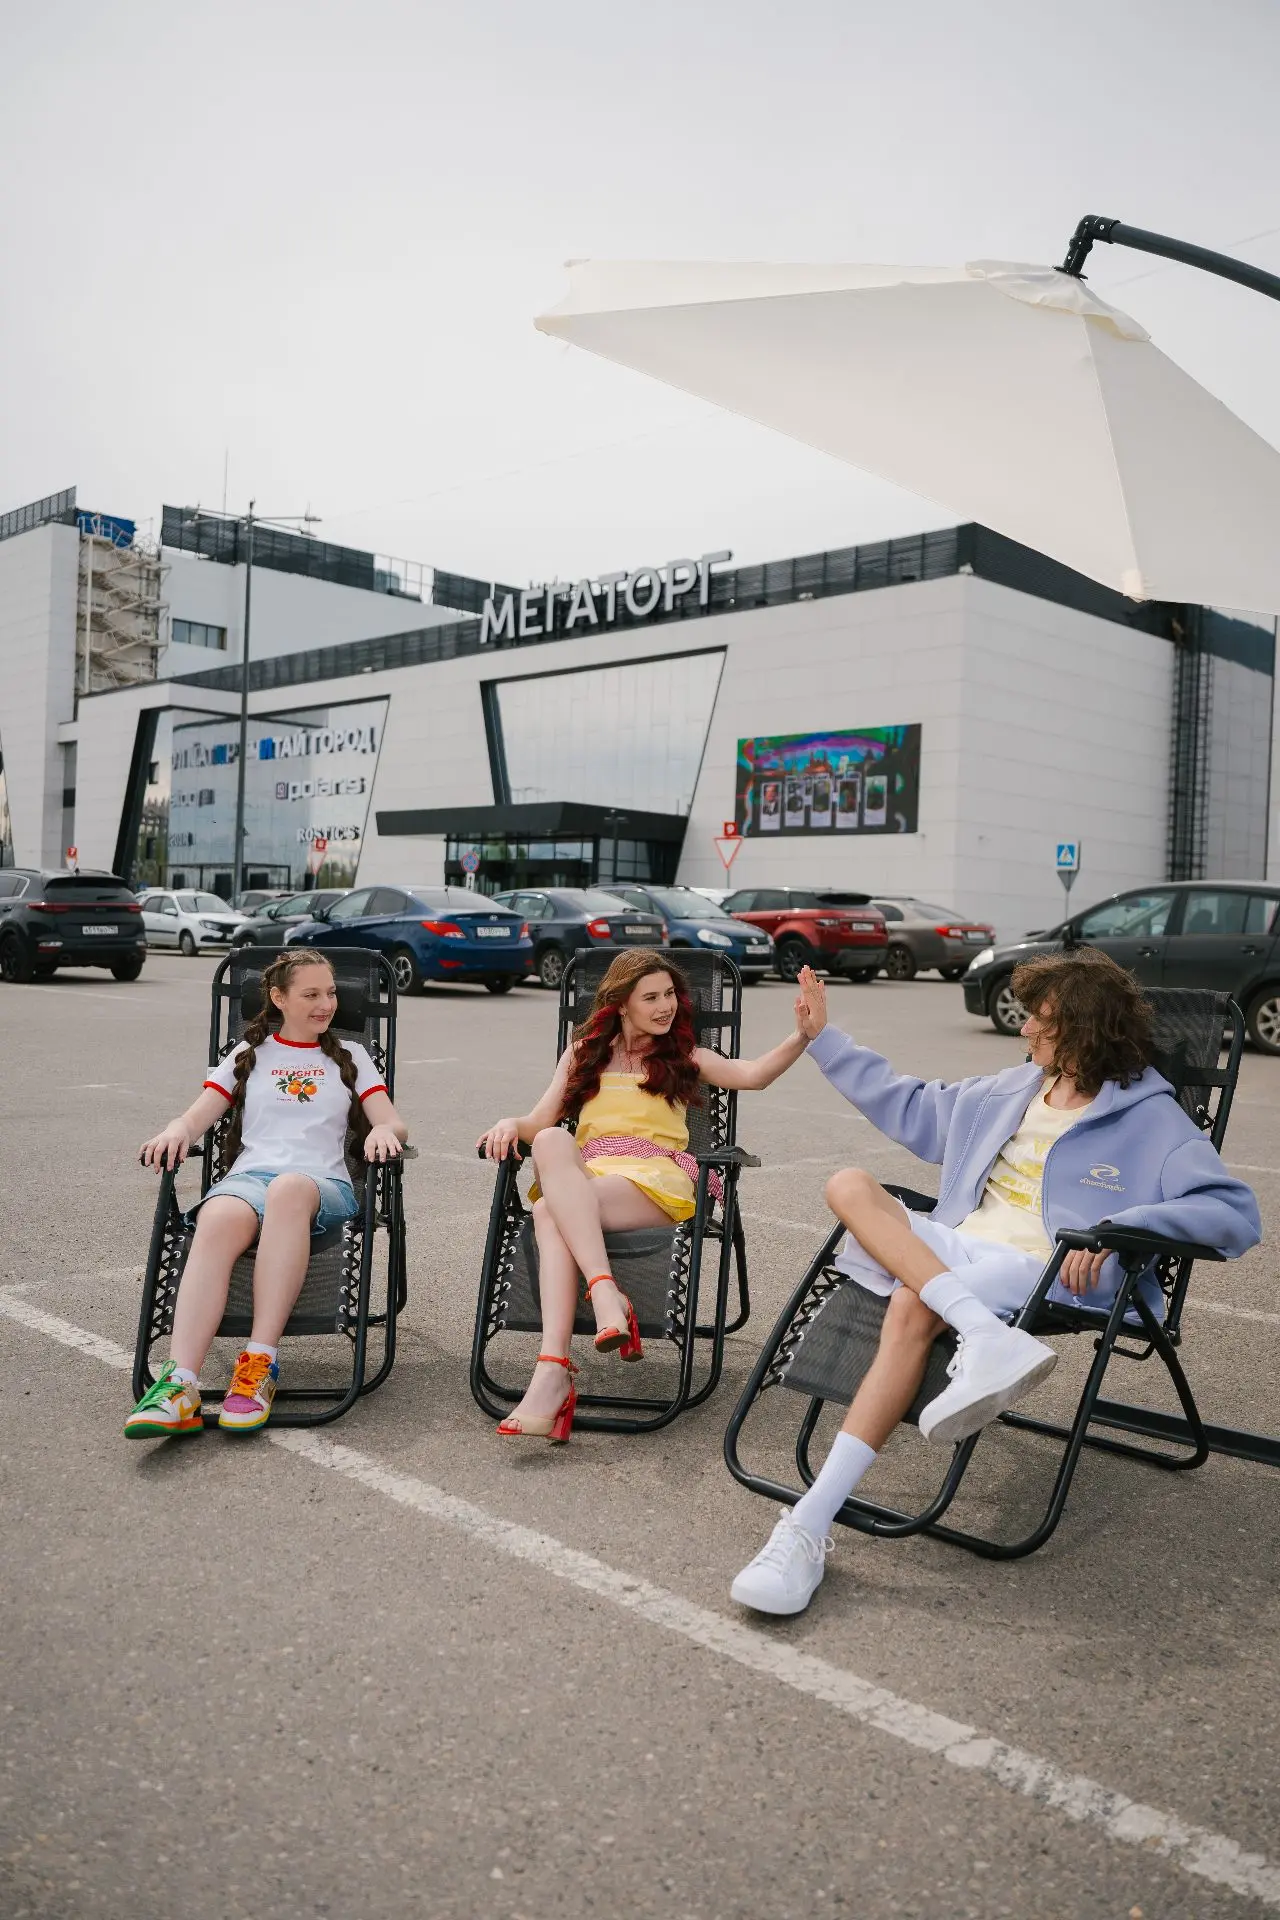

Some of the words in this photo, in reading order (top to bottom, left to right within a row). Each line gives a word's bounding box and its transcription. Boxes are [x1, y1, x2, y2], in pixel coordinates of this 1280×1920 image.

[480, 550, 733, 644] МЕГАТОРГ
[311, 726, 376, 754] ГОРОД
[271, 1068, 325, 1077] DELIGHTS
